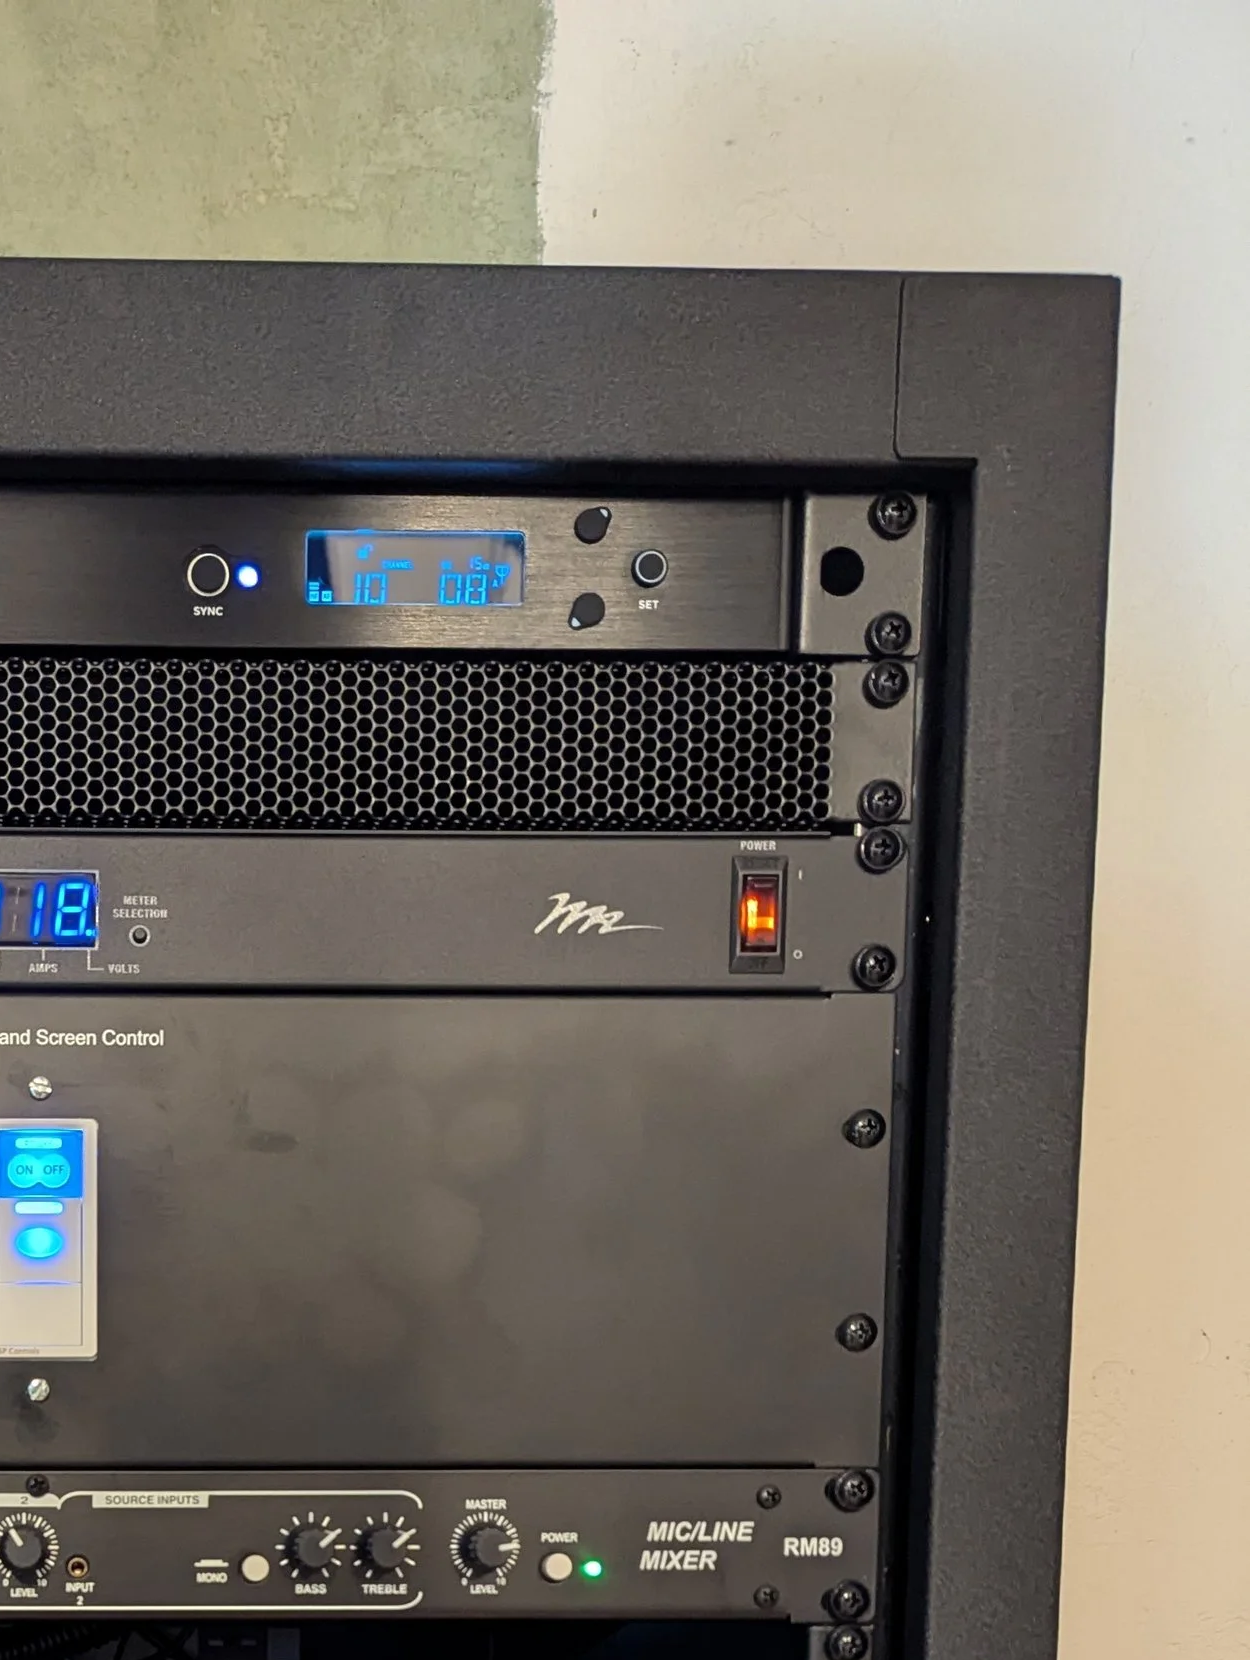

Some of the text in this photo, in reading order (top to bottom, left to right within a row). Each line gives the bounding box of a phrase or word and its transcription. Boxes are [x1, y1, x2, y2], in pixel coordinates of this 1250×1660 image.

[354, 573, 387, 604] 10
[440, 573, 487, 605] 08
[637, 599, 659, 610] SET
[192, 605, 224, 617] SYNC
[740, 840, 776, 850] POWER
[123, 895, 158, 905] METER
[112, 909, 168, 919] SELECTION
[28, 963, 58, 973] AMPS
[108, 964, 140, 974] VOLTS
[36, 1029, 97, 1046] Screen
[101, 1030, 164, 1046] Control
[15, 1164, 33, 1175] ON
[43, 1164, 64, 1175] OFF
[20, 1497, 29, 1505] 2
[105, 1495, 200, 1505] SOURCE INPUTS
[465, 1499, 507, 1510] MASTER
[646, 1521, 755, 1542] MIC/LINE
[541, 1532, 578, 1543] POWER
[783, 1537, 843, 1557] RM89
[639, 1550, 718, 1571] MIXER
[2, 1578, 9, 1587] 0
[37, 1578, 47, 1587] 10
[196, 1572, 228, 1583] MONO
[461, 1577, 468, 1586] 0
[497, 1577, 507, 1586] 10
[10, 1588, 38, 1598] LEVEL
[65, 1582, 95, 1593] INPUT
[294, 1584, 327, 1595] BASS
[362, 1584, 408, 1595] TREBLE
[470, 1584, 498, 1594] LEVEL
[76, 1596, 83, 1605] 2
